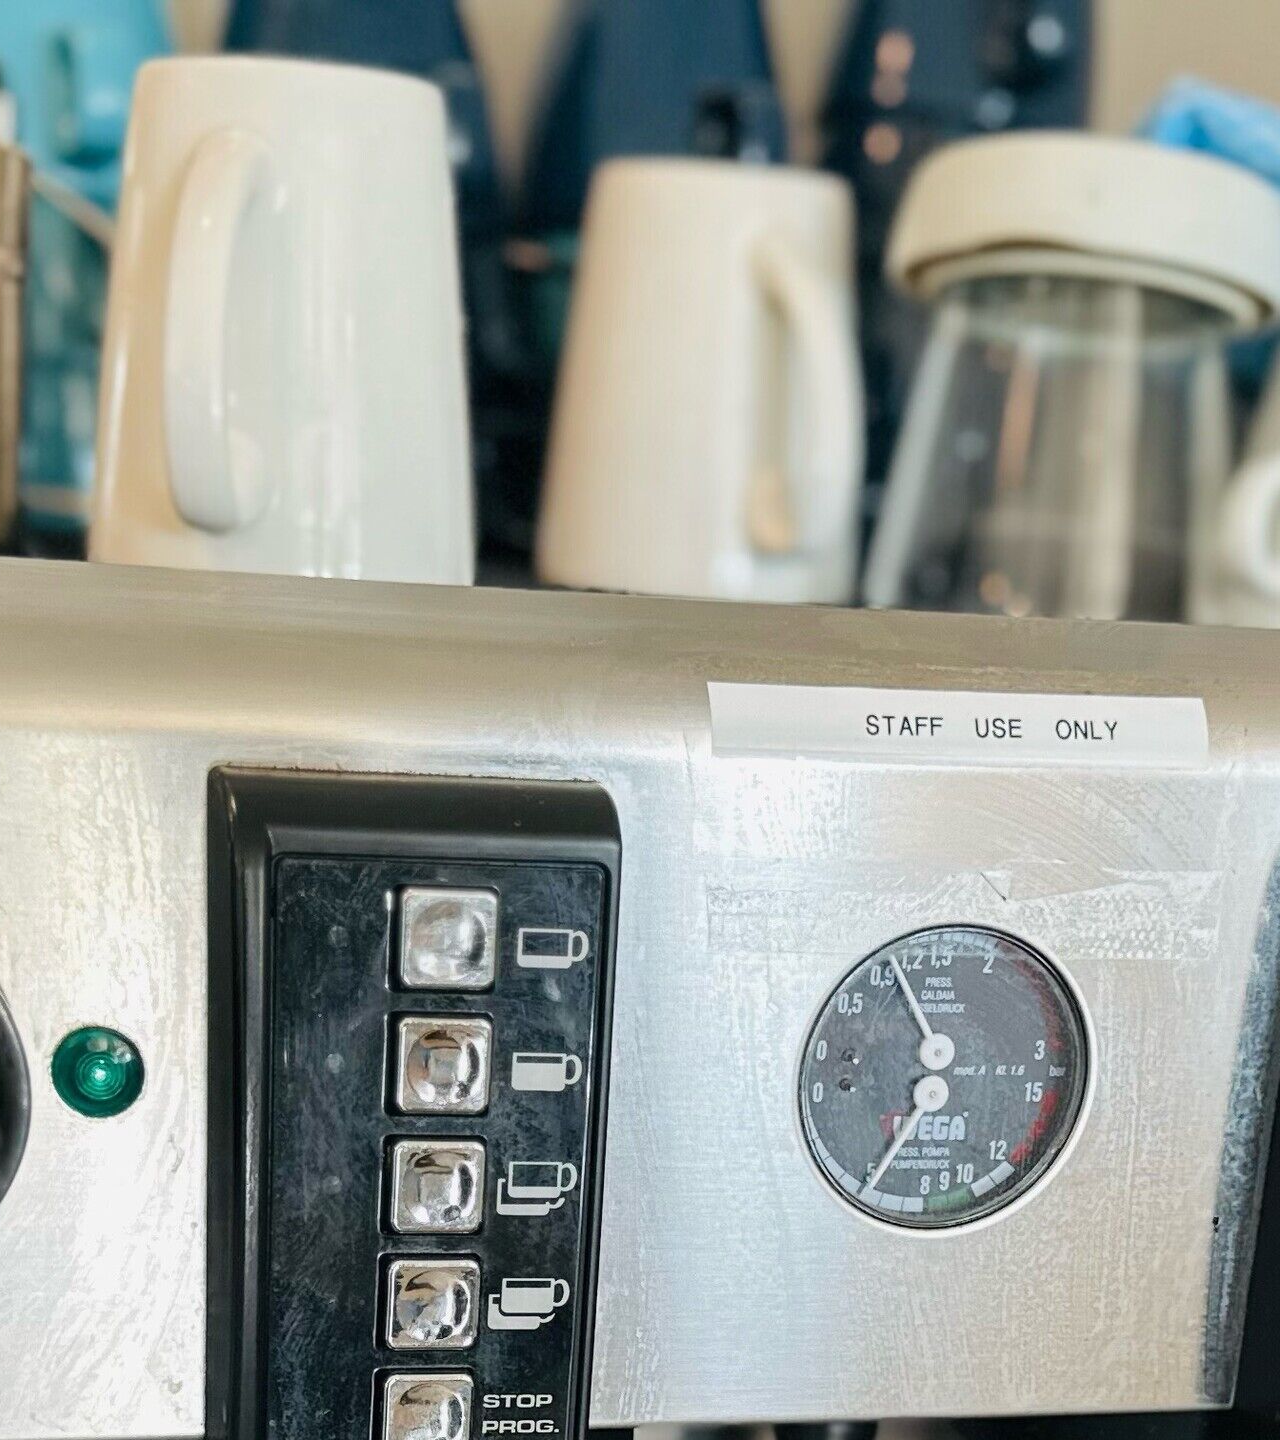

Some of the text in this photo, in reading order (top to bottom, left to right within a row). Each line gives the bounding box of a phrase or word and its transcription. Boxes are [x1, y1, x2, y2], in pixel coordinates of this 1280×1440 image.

[865, 715, 1120, 742] STAFF USE ONLY
[982, 951, 997, 974] 2
[869, 964, 895, 989] 0,9
[838, 991, 864, 1017] 0,5
[816, 1039, 828, 1061] 0
[1033, 1039, 1046, 1061] 3
[812, 1082, 824, 1103] 0
[1024, 1081, 1044, 1103] 15
[892, 1115, 966, 1141] WEGA
[988, 1140, 1008, 1160] 12
[939, 1171, 951, 1191] 9
[956, 1163, 975, 1184] 10
[919, 1175, 931, 1195] 8
[482, 1393, 553, 1409] STOP
[481, 1419, 560, 1435] PROG.
